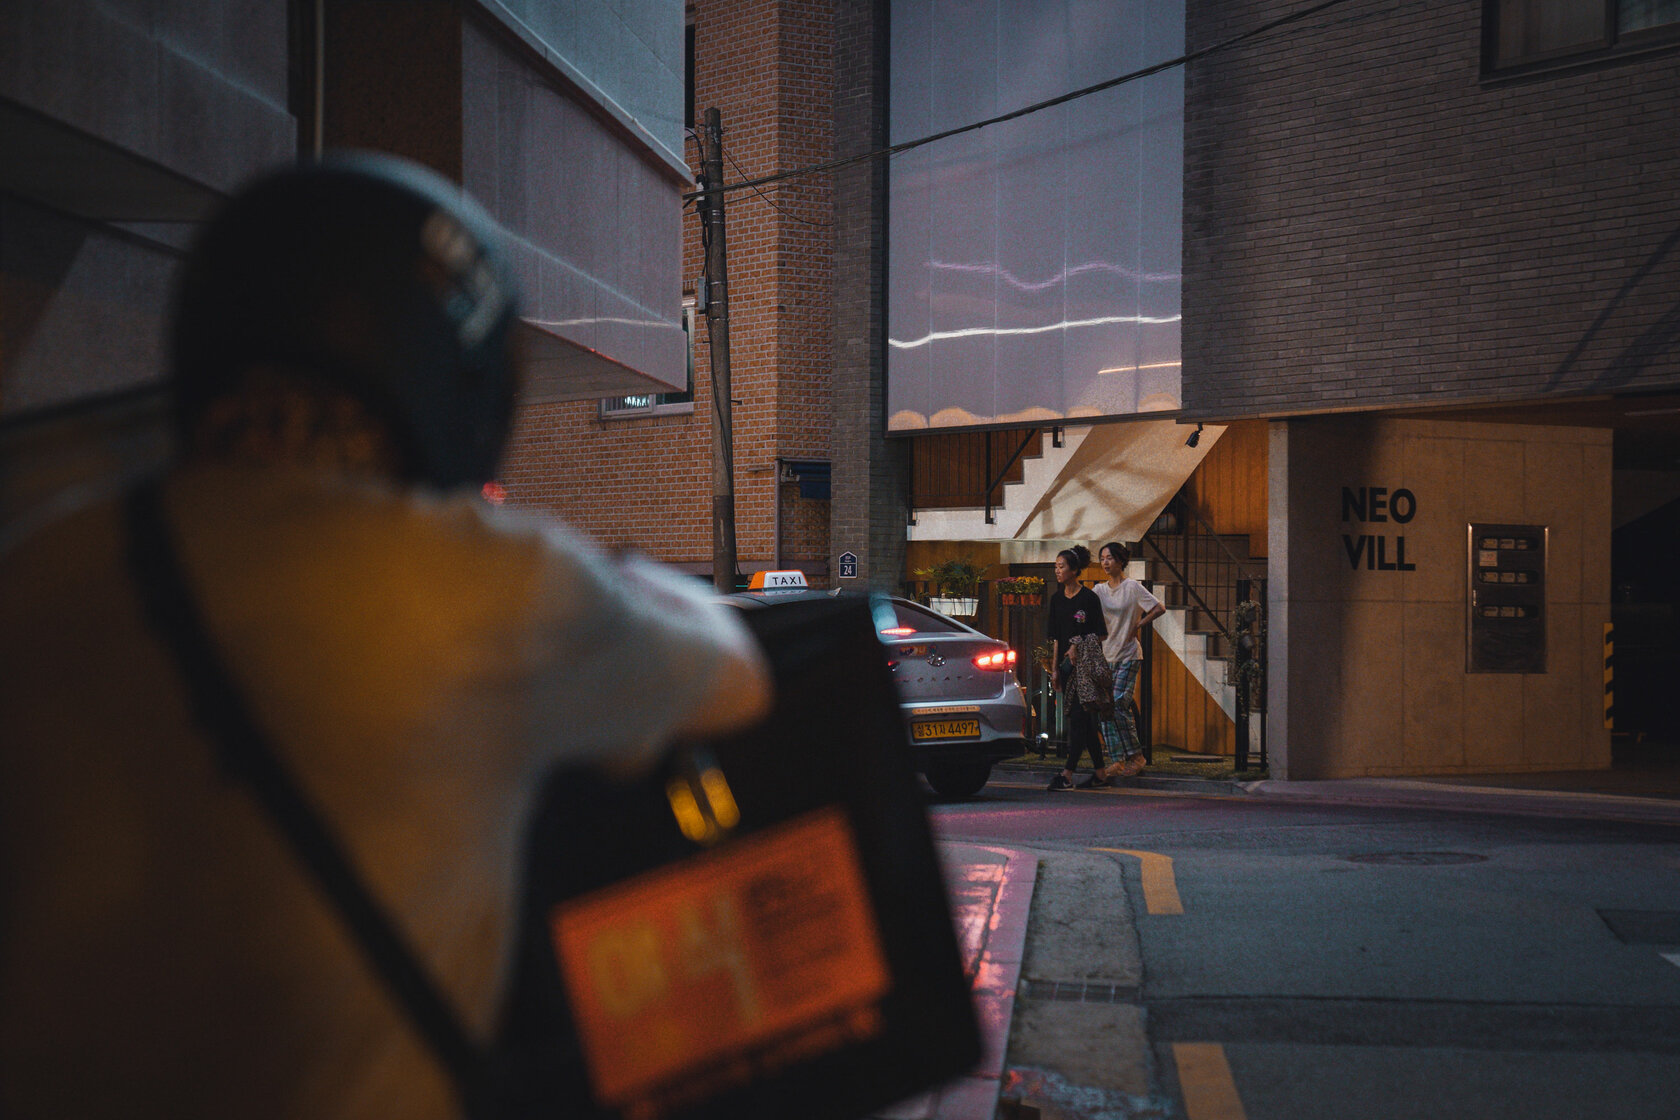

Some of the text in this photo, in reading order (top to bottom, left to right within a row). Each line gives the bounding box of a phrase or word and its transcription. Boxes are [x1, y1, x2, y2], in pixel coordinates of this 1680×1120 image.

[1341, 487, 1417, 524] NEO
[1342, 534, 1416, 571] VILL
[772, 576, 802, 586] TAXI
[843, 565, 852, 575] 24
